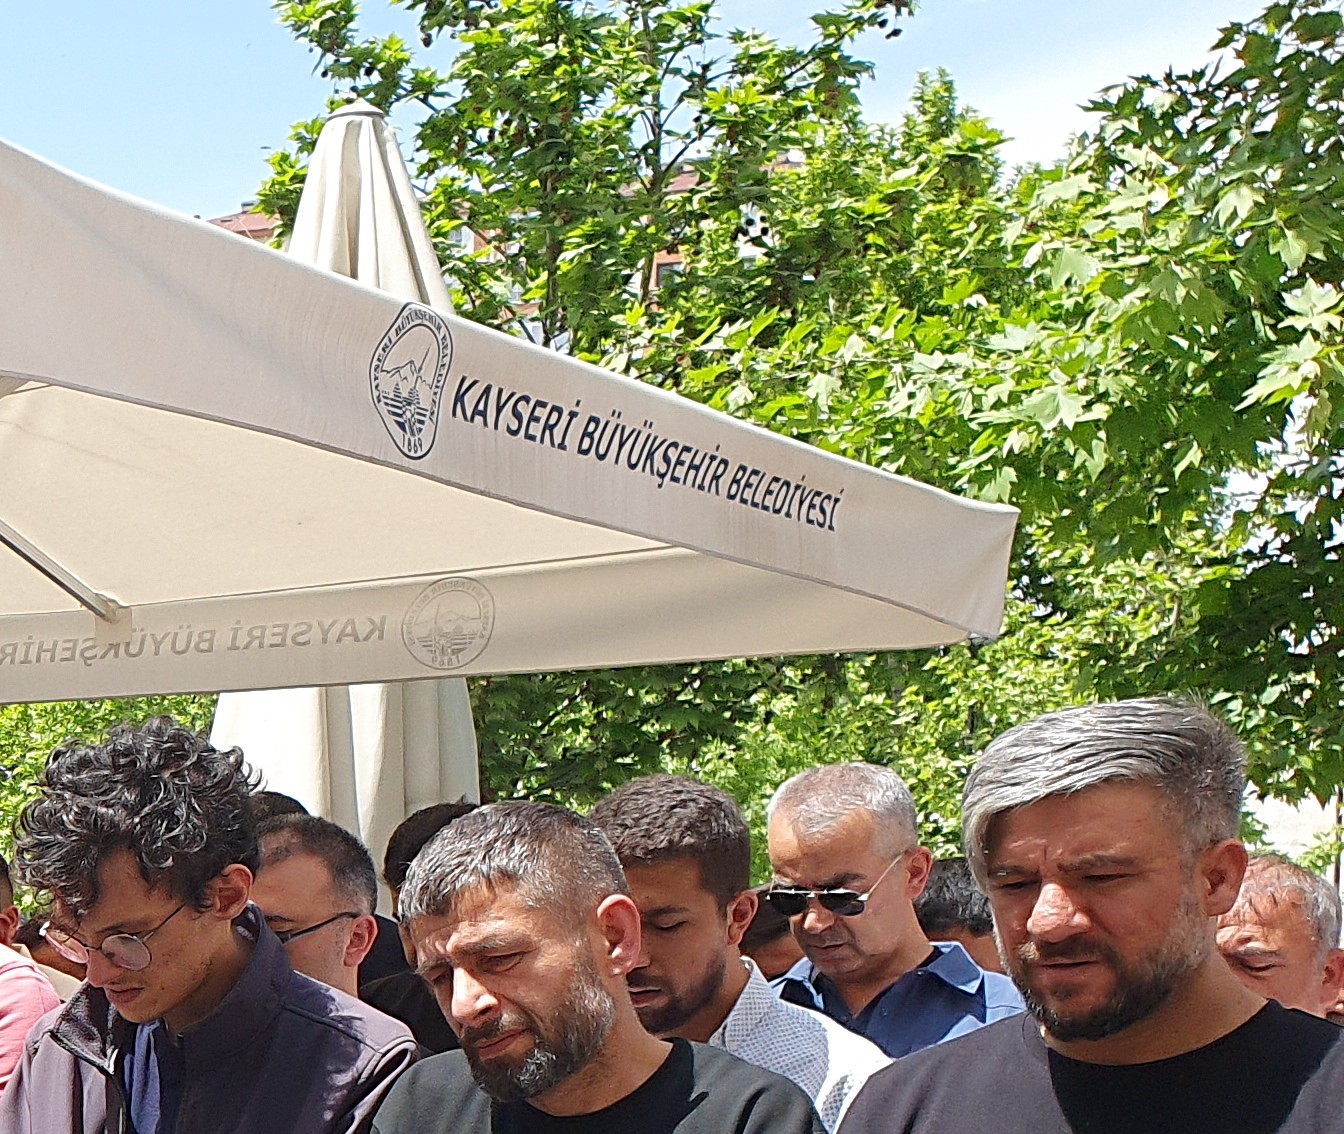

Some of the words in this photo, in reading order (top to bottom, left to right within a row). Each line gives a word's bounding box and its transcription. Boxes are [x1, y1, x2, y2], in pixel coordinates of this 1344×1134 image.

[402, 433, 423, 455] 1869
[451, 374, 581, 451] KAYSERİ
[577, 409, 731, 496] BÜYÜKŞEHİR
[725, 462, 845, 533] BELEDİYESİ
